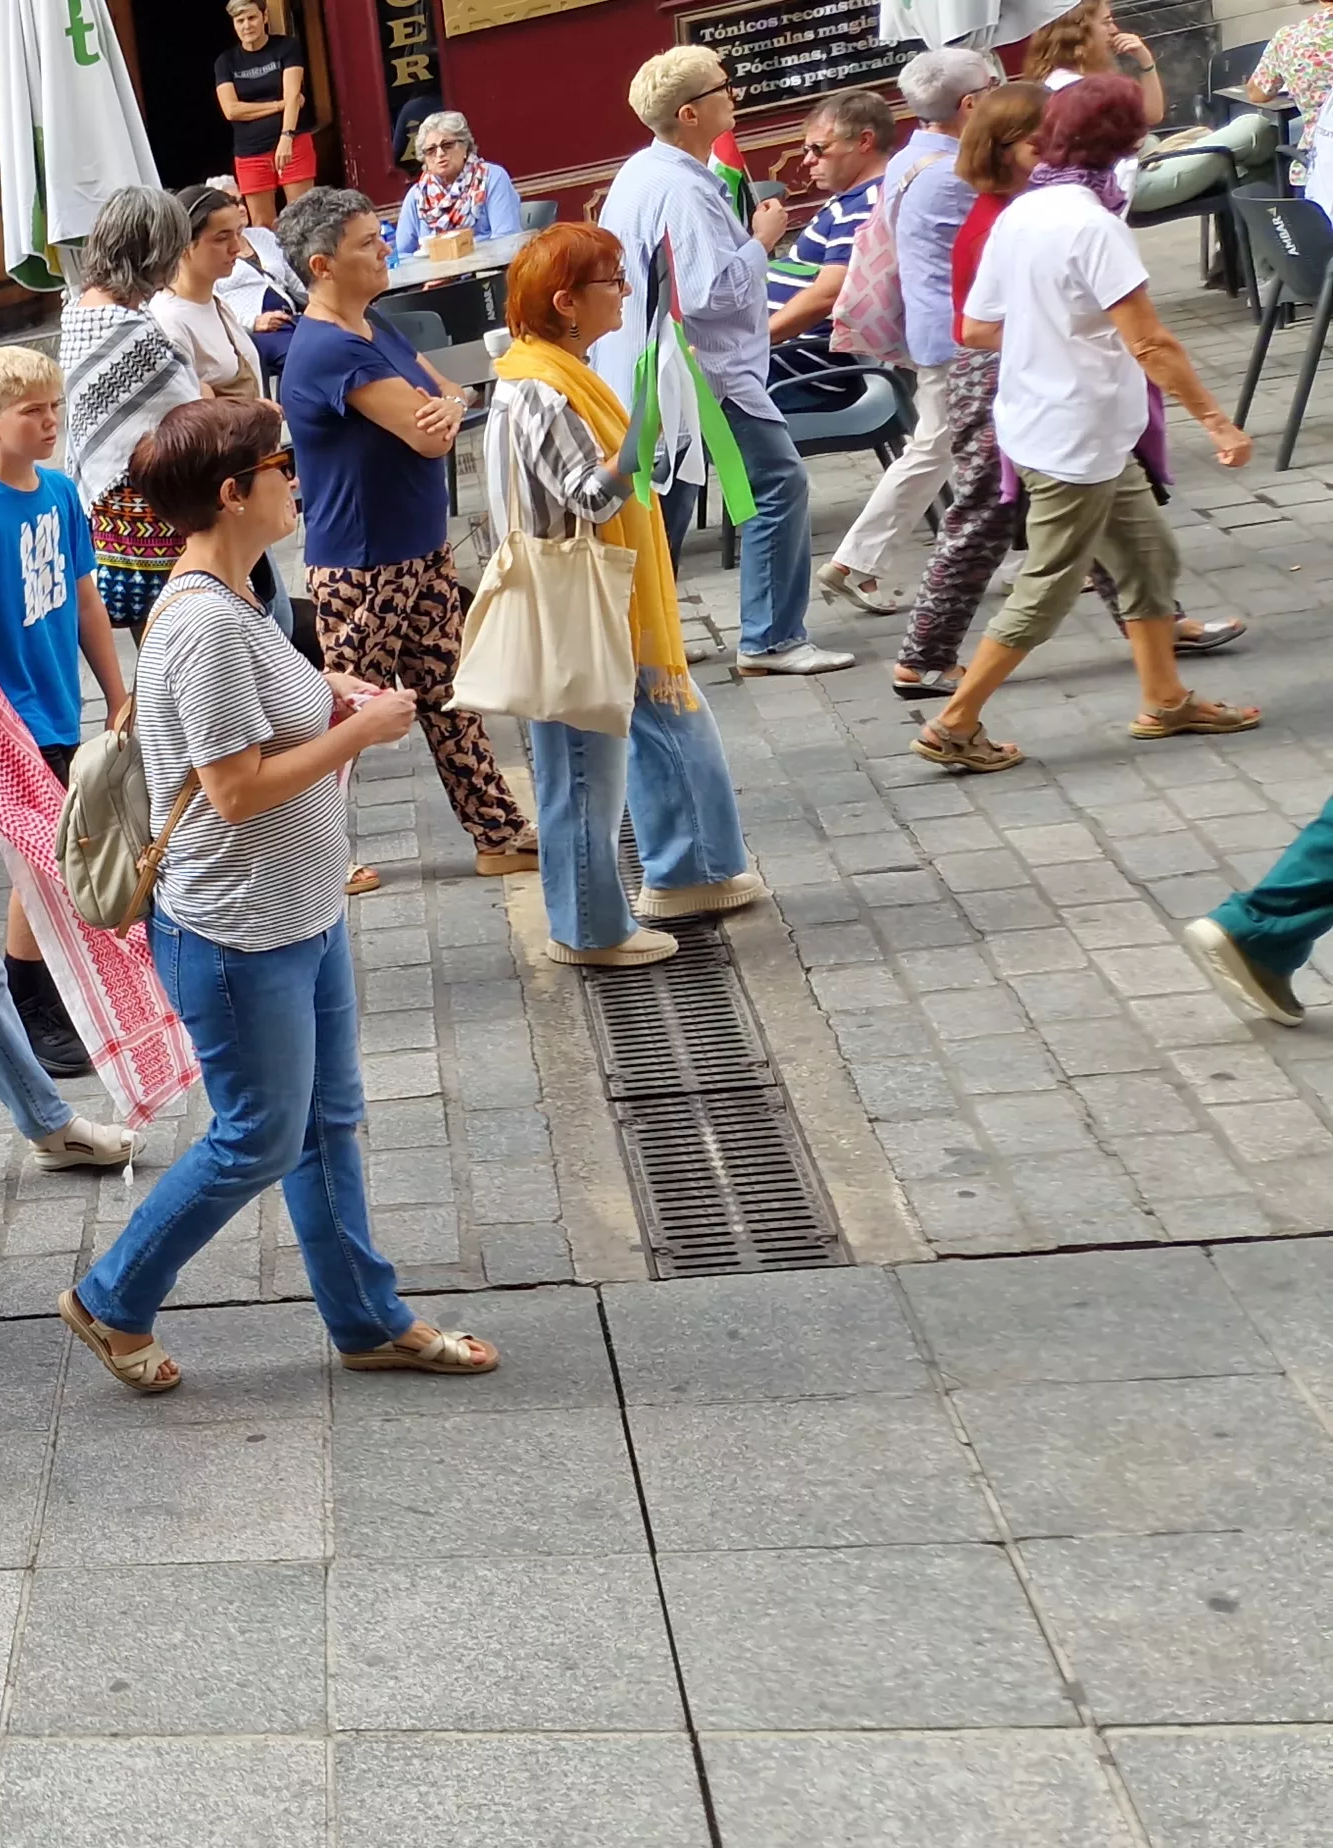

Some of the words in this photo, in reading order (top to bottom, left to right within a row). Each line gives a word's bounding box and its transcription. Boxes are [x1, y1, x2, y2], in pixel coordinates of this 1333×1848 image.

[700, 14, 779, 43] Tónicos
[717, 25, 815, 61] Fórmulas
[734, 86, 748, 101] y
[750, 74, 802, 97] otros
[802, 50, 919, 87] preparados
[735, 44, 827, 78] Pócimas,
[1271, 215, 1300, 256] AMBAR
